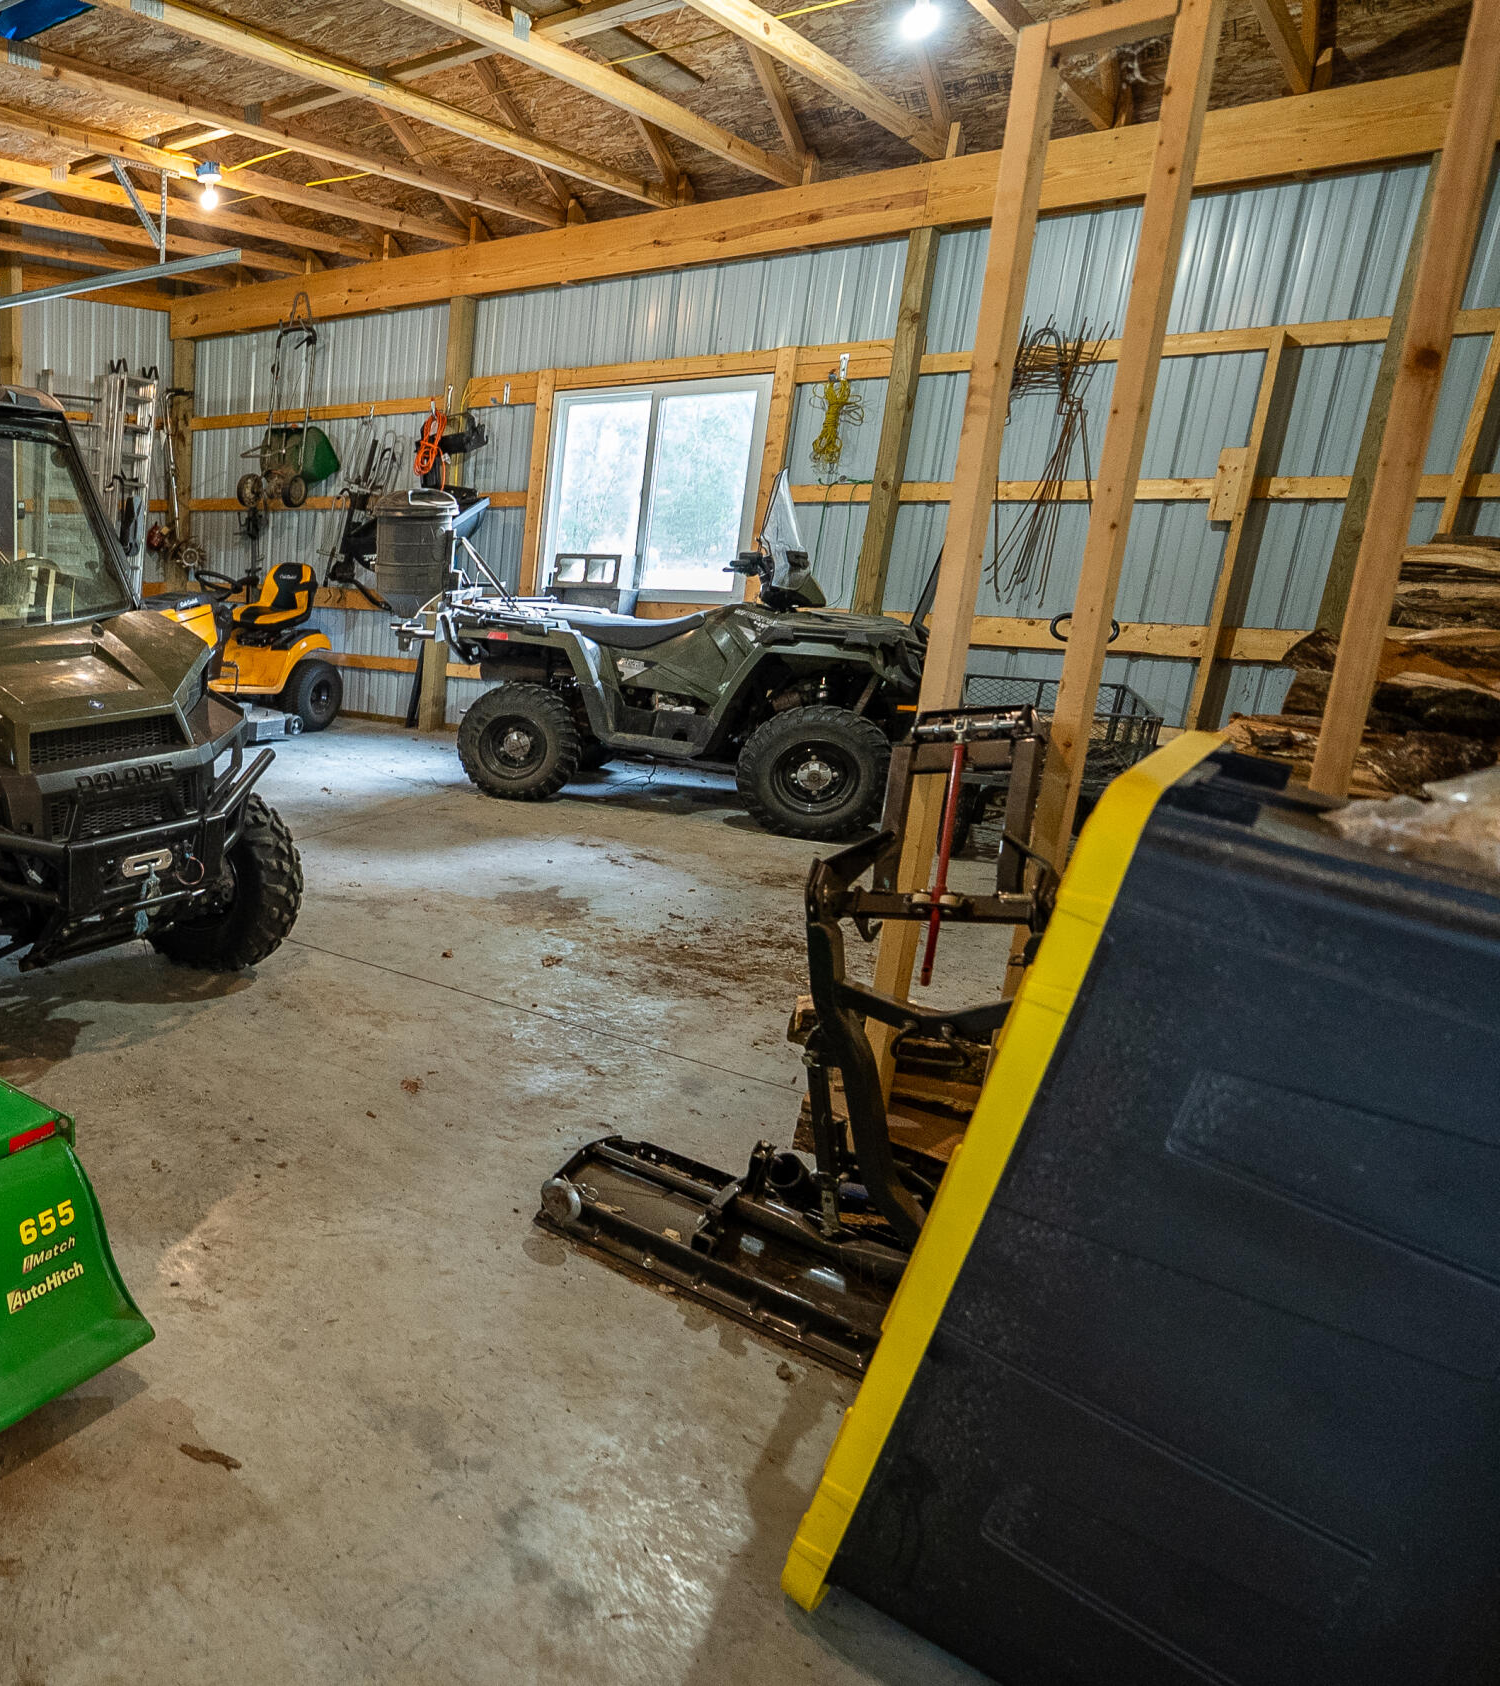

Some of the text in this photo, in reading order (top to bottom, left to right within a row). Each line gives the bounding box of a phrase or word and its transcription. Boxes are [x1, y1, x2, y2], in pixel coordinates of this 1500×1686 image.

[75, 761, 175, 794] POLARIS
[19, 1199, 75, 1246] 655
[6, 1261, 84, 1315] AutoHitch
